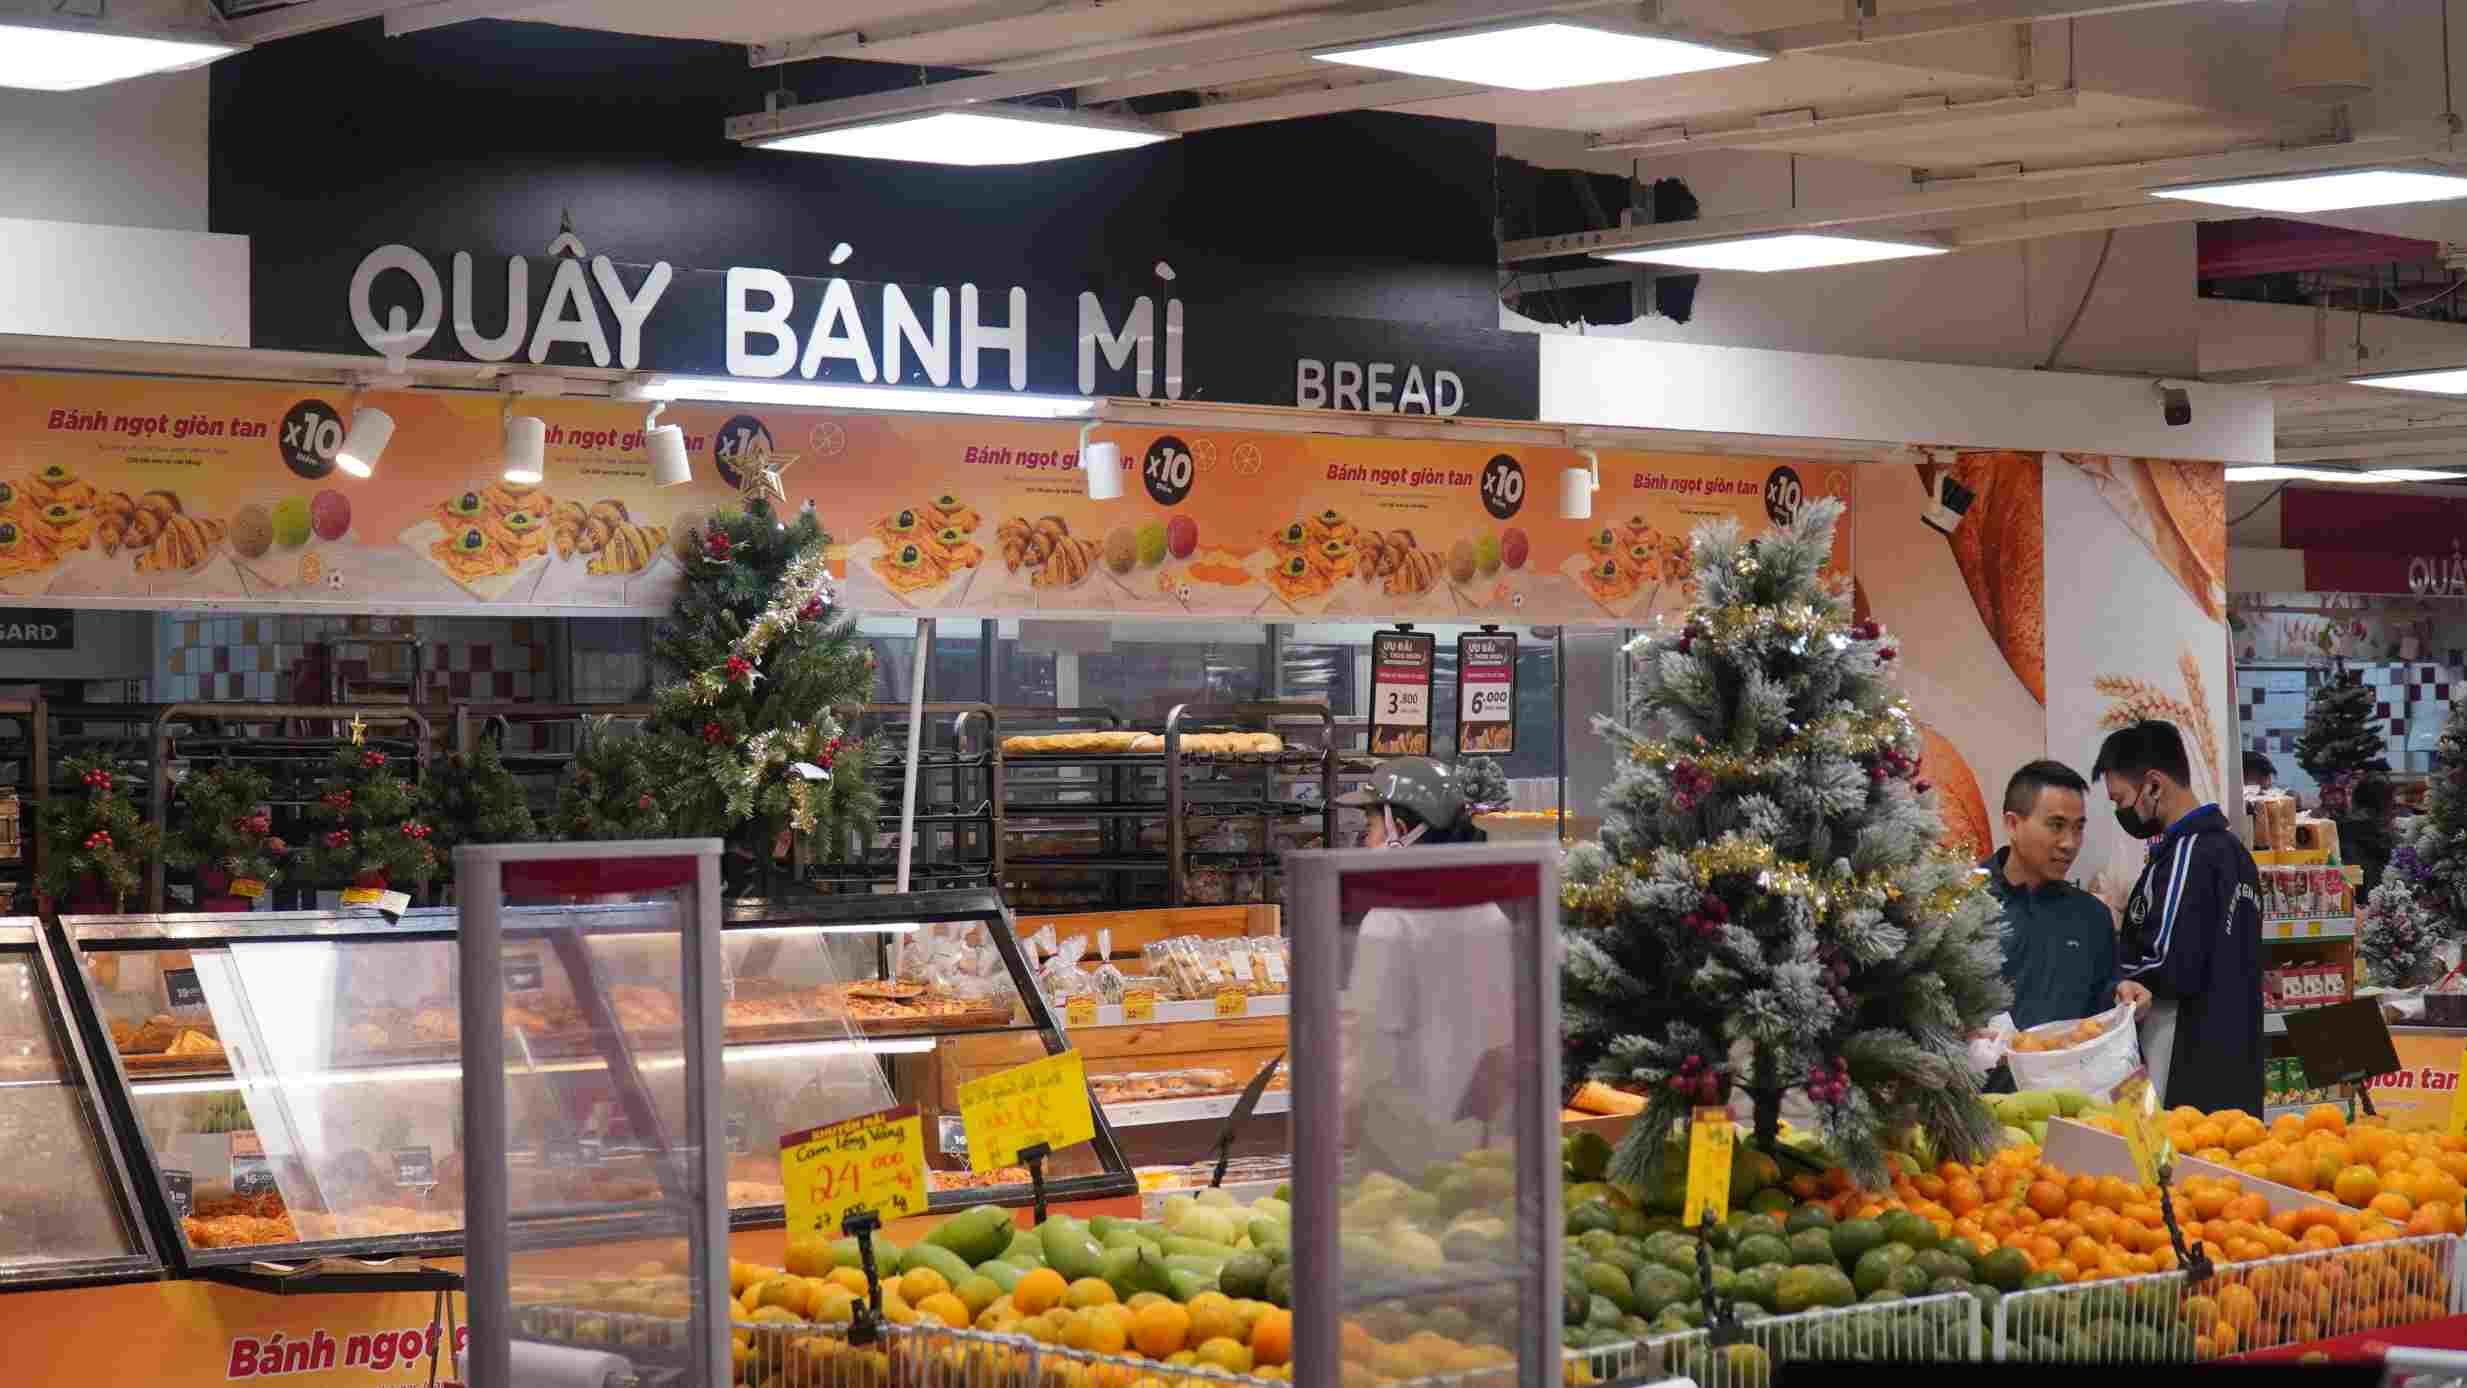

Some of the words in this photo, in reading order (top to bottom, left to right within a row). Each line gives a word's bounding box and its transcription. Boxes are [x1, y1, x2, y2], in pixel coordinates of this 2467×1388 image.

[724, 242, 1028, 392] BÁNH
[1077, 260, 1184, 400] MÌ
[1297, 358, 1464, 417] BREAD
[48, 409, 107, 432] Bánh
[112, 412, 169, 437] ngọt
[230, 417, 268, 438] tan
[284, 412, 343, 458] x10
[568, 428, 617, 450] ngọt
[964, 444, 1011, 465] Bánh
[1016, 449, 1058, 470] ngọt
[1146, 447, 1193, 488] x10
[1327, 463, 1367, 481] Bánh
[1370, 466, 1407, 487] ngọt
[1448, 469, 1473, 486] tan
[1483, 465, 1523, 503] x10
[1632, 472, 1668, 490] Bánh
[1671, 476, 1703, 494] ngọt
[1737, 480, 1759, 496] tan
[1767, 475, 1801, 512] x10
[229, 1328, 335, 1379] Bánh
[344, 1322, 442, 1370] ngọt
